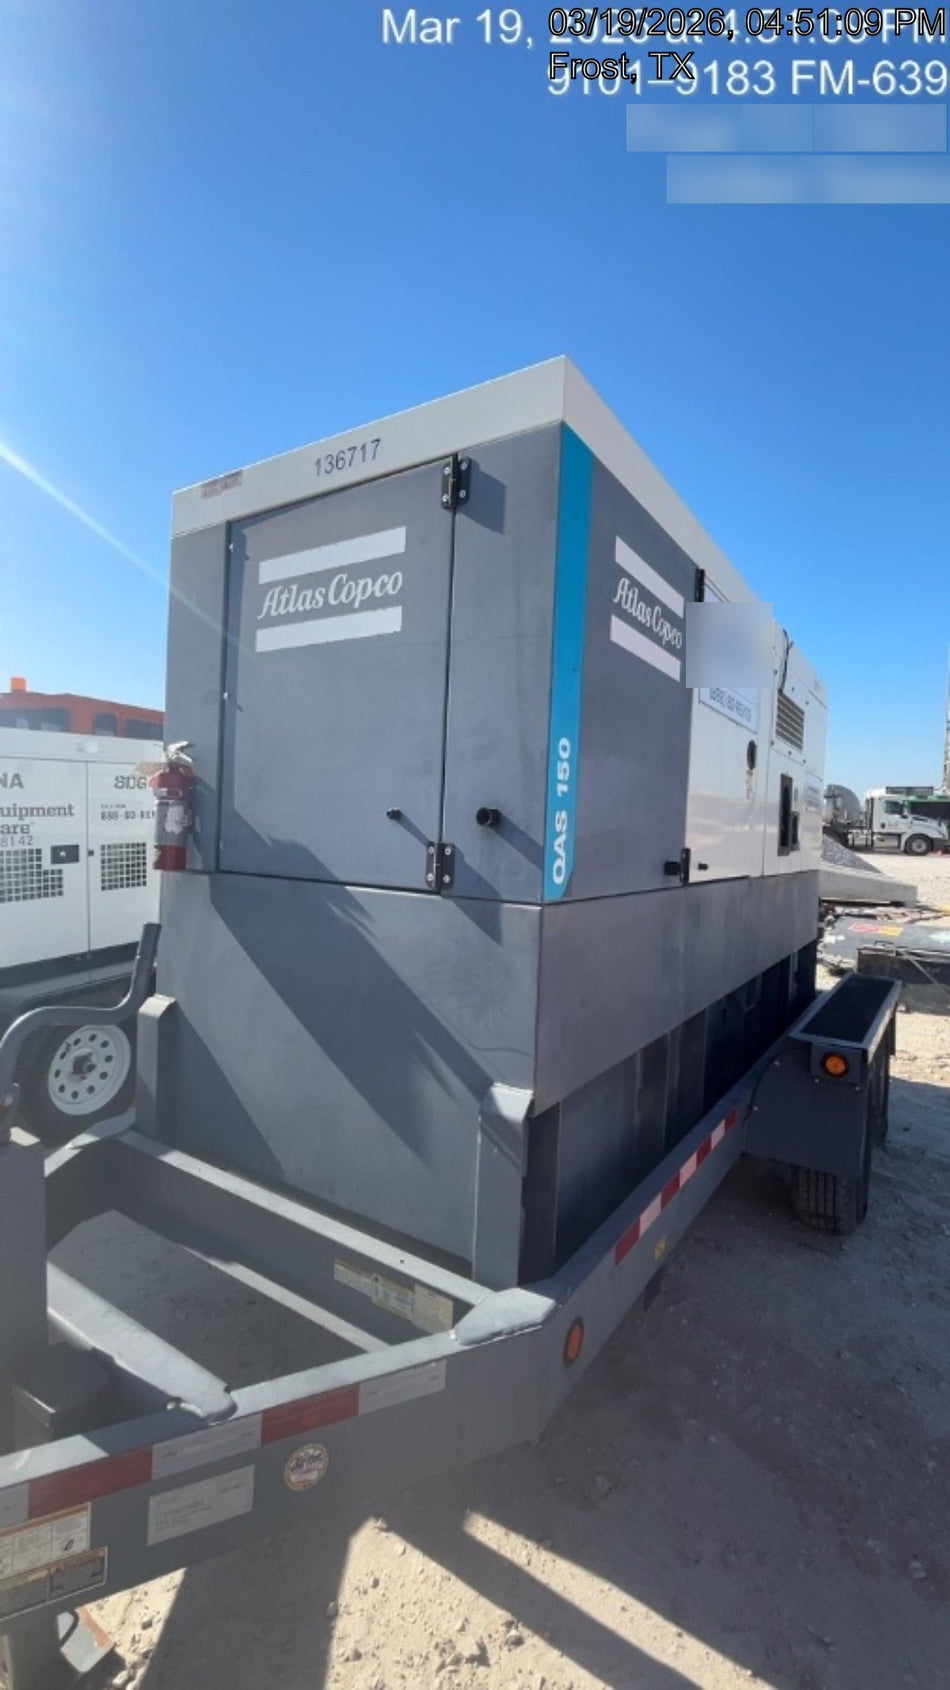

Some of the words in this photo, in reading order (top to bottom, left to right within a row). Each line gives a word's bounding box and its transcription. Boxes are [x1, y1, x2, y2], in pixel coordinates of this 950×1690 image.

[315, 437, 381, 477] 136717
[257, 584, 325, 620] Atlas
[328, 571, 403, 609] Copco
[612, 577, 652, 628] Atlas
[652, 606, 682, 649] Copco
[557, 737, 571, 797] 150
[553, 810, 568, 885] QAS
